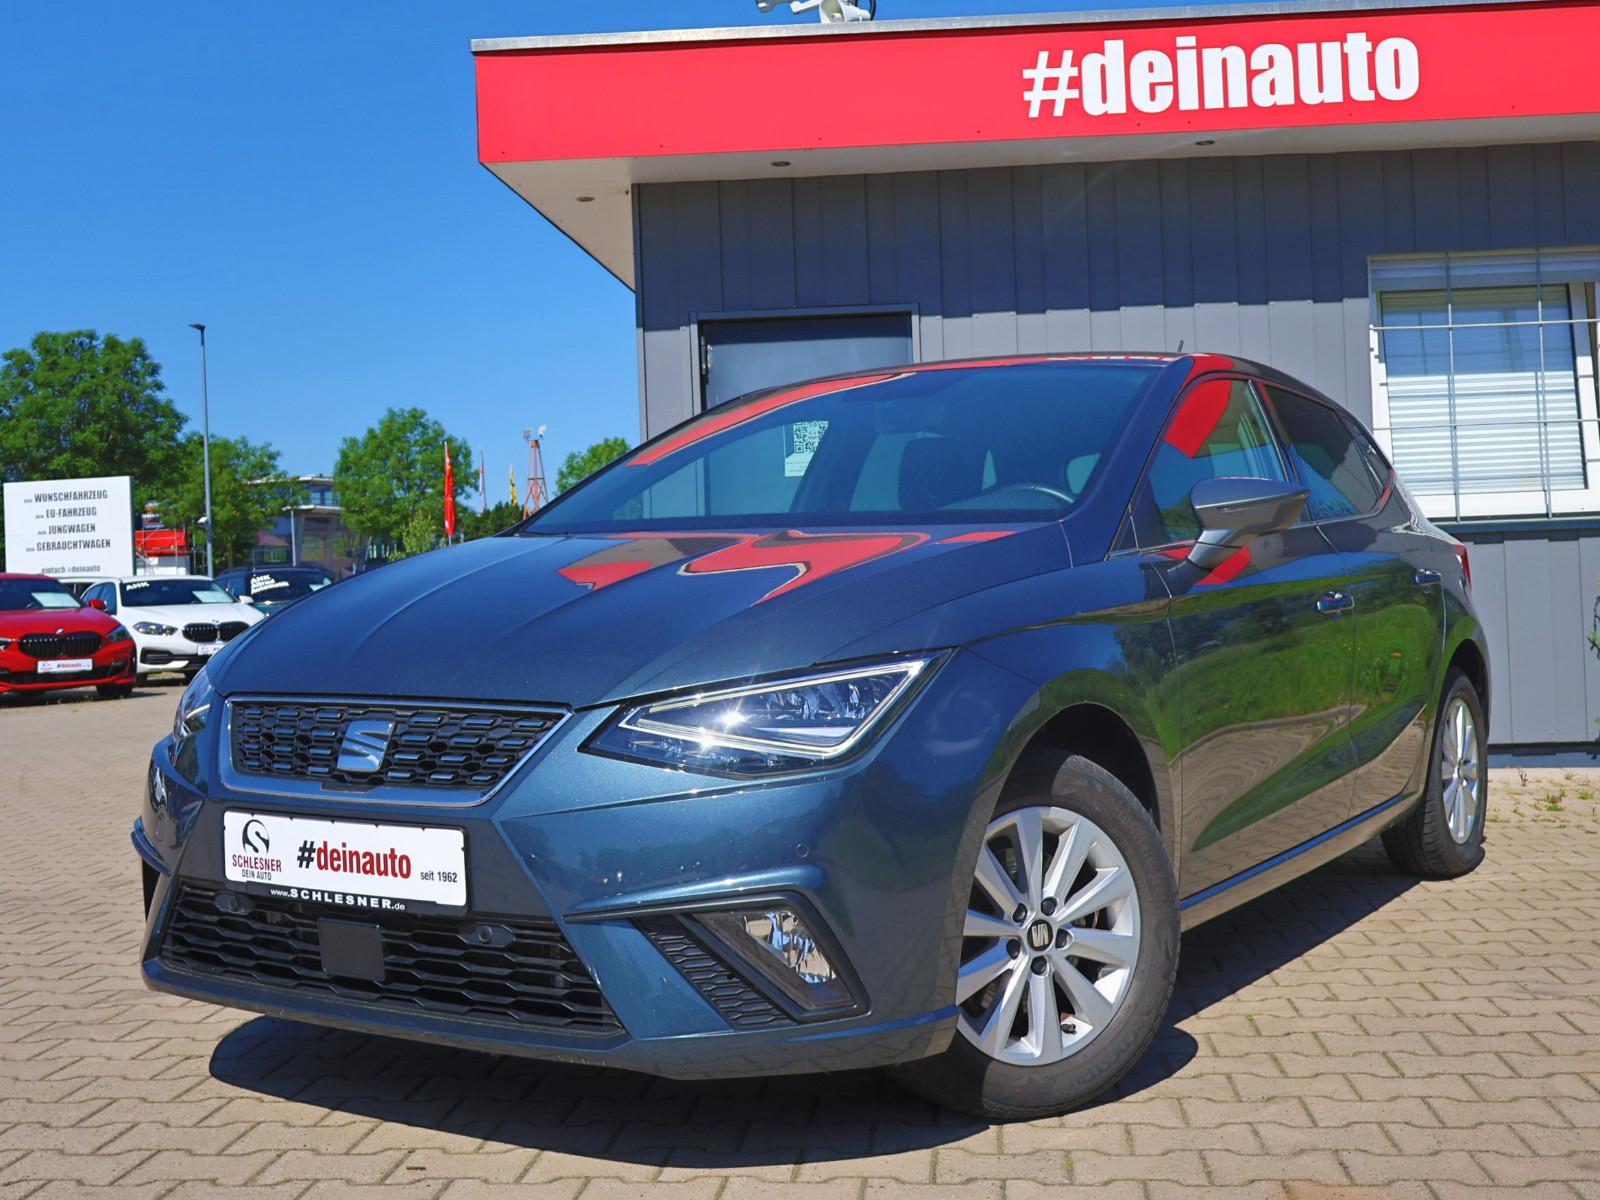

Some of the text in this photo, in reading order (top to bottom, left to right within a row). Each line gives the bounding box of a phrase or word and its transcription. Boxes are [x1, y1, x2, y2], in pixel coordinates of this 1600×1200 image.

[1022, 32, 1420, 118] #deinauto
[34, 490, 108, 503] WUNSCHFAHRZEUG
[46, 507, 97, 518] EU-FAHRZEUG
[48, 523, 96, 535] JUNGWAGEN
[36, 539, 111, 551] GEBRAUCHTWAGEN
[232, 854, 282, 872] SCHLESNER
[297, 840, 412, 879] #deinauto
[242, 869, 272, 881] DEIN AUTO
[420, 870, 458, 883] seit 1962
[270, 888, 405, 911] www.SCHLESNER.de
